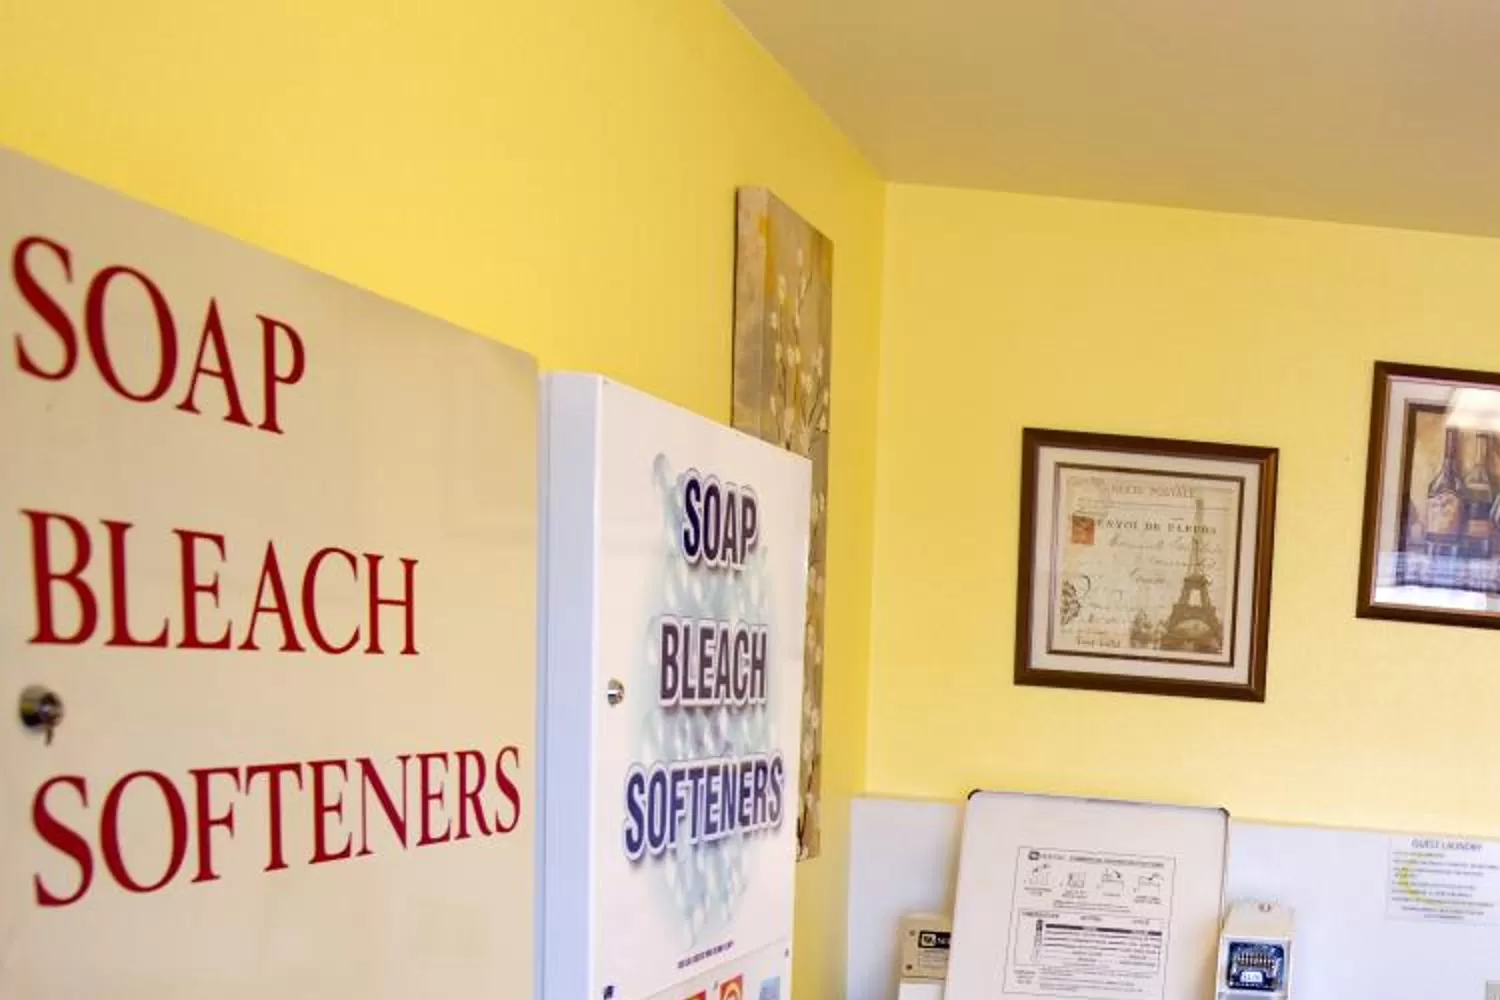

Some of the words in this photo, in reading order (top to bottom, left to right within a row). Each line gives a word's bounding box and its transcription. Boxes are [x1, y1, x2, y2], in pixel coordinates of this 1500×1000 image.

[10, 236, 305, 435] SOAP
[20, 509, 420, 656] BLEACH
[682, 475, 759, 571] SOAP
[660, 619, 768, 709] BLEACH
[31, 746, 521, 908] SOFTENERS
[624, 752, 784, 861] SOFTENERS
